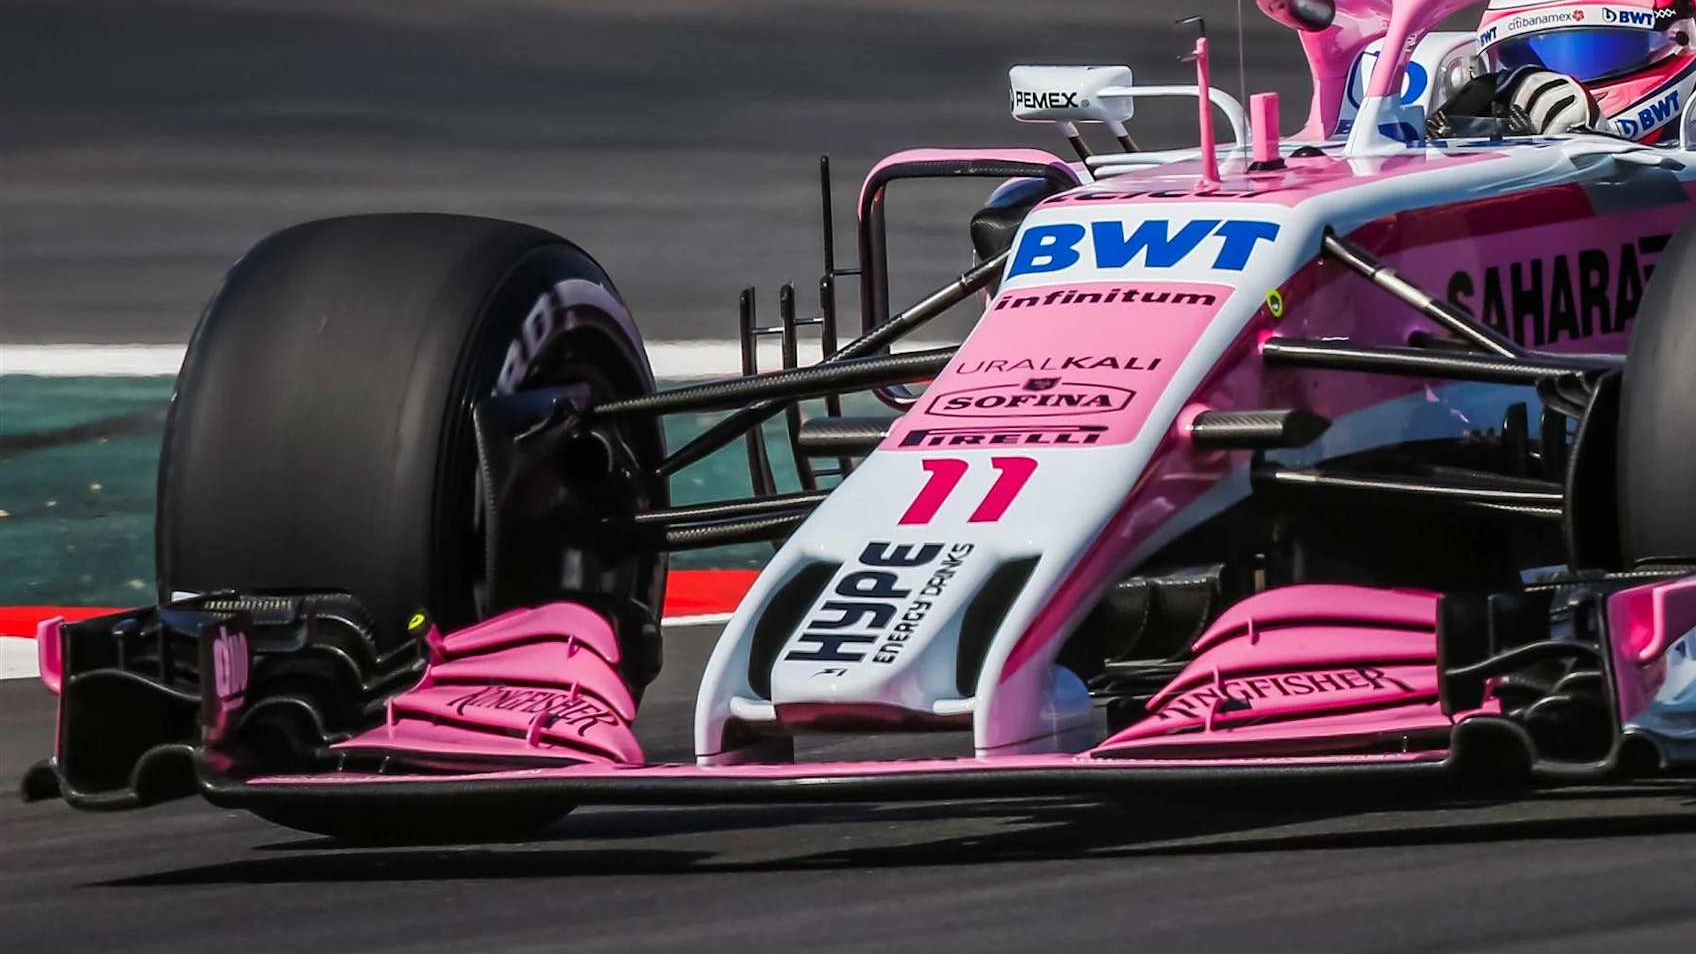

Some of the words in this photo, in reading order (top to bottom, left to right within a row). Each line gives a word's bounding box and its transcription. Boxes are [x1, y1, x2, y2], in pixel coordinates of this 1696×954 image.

[1508, 13, 1572, 31] citibanamex
[1618, 10, 1653, 26] BWT
[1016, 91, 1079, 109] PEMEX
[1638, 90, 1680, 131] BWT
[1004, 219, 1282, 282] BWT
[994, 288, 1216, 311] infinitum
[956, 357, 1161, 375] URALKALI
[943, 393, 1112, 410] SOFINA
[898, 425, 1109, 448] PIRELLI
[897, 456, 1038, 526] 11
[920, 543, 975, 596] DRINKS
[784, 542, 945, 662] HYPE
